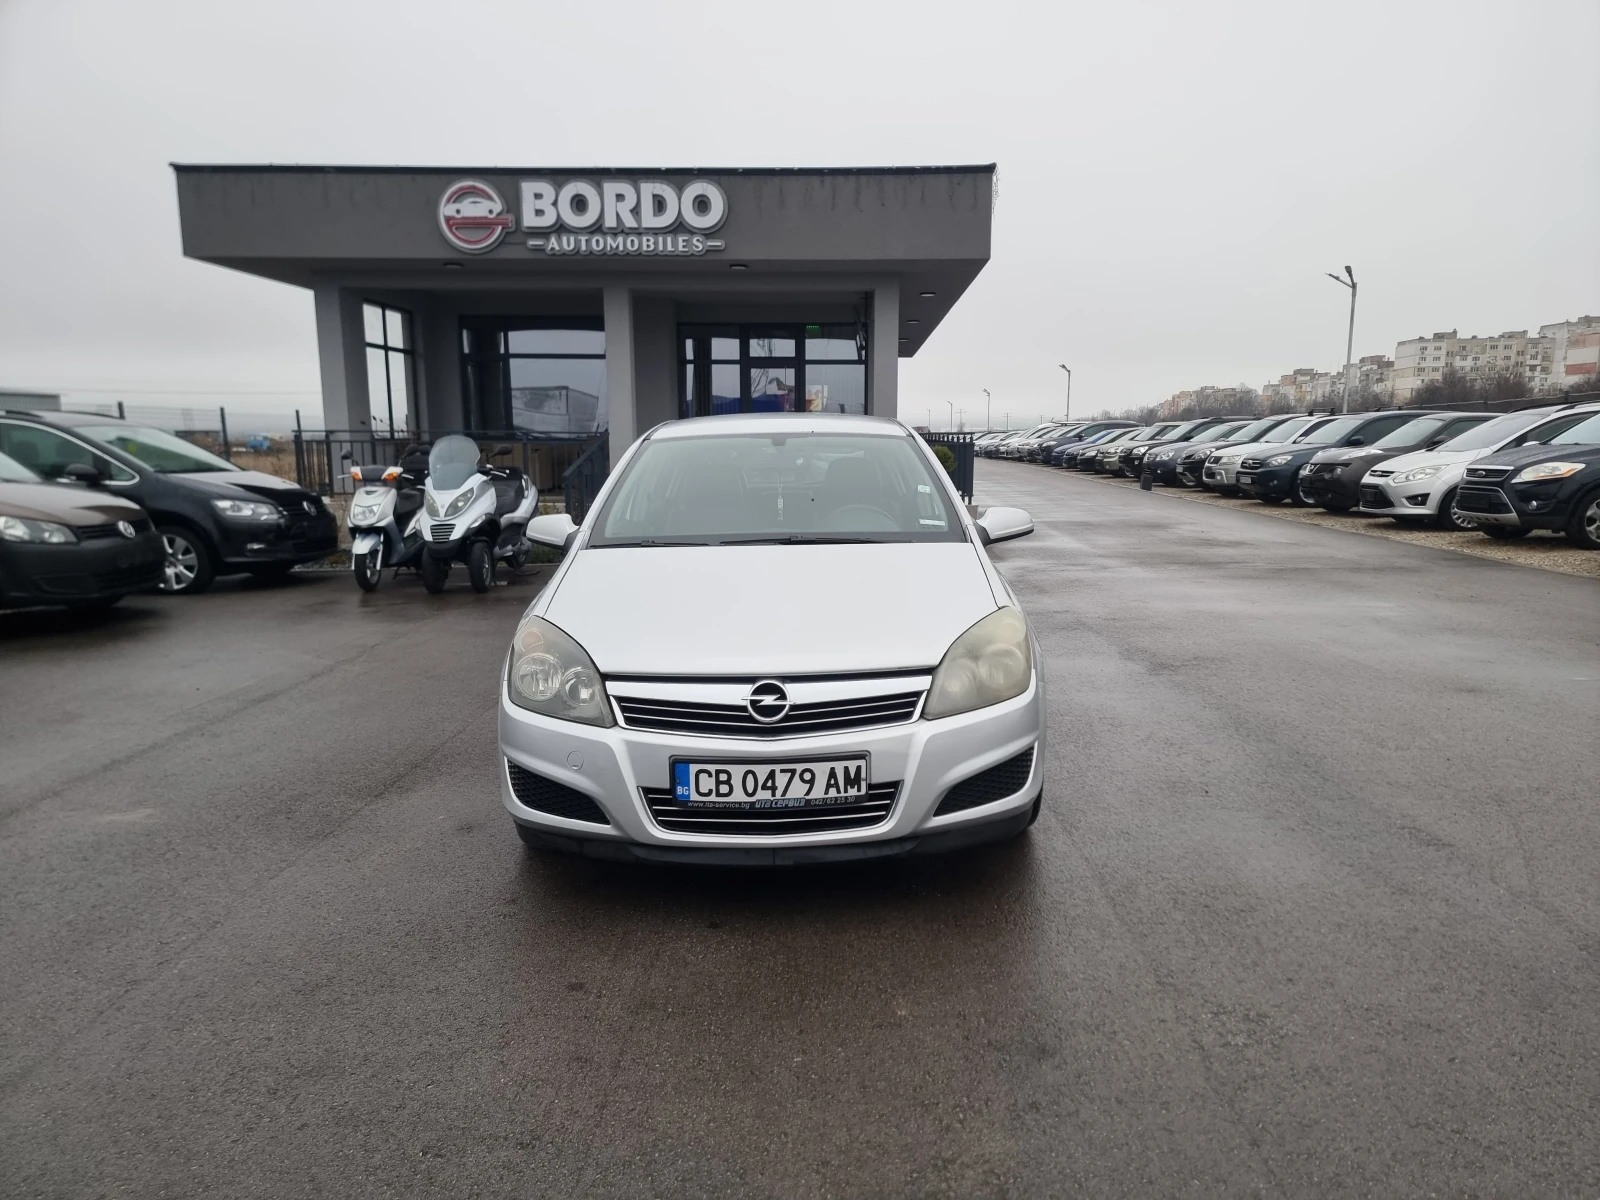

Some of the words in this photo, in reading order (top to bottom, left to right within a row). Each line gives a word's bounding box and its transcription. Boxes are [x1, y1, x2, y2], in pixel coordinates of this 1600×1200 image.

[521, 181, 724, 228] BORDO
[547, 236, 703, 251] AUTOMOBILES
[677, 786, 689, 795] BG
[694, 769, 733, 798] CB
[741, 768, 816, 798] 0479
[823, 765, 862, 795] AM
